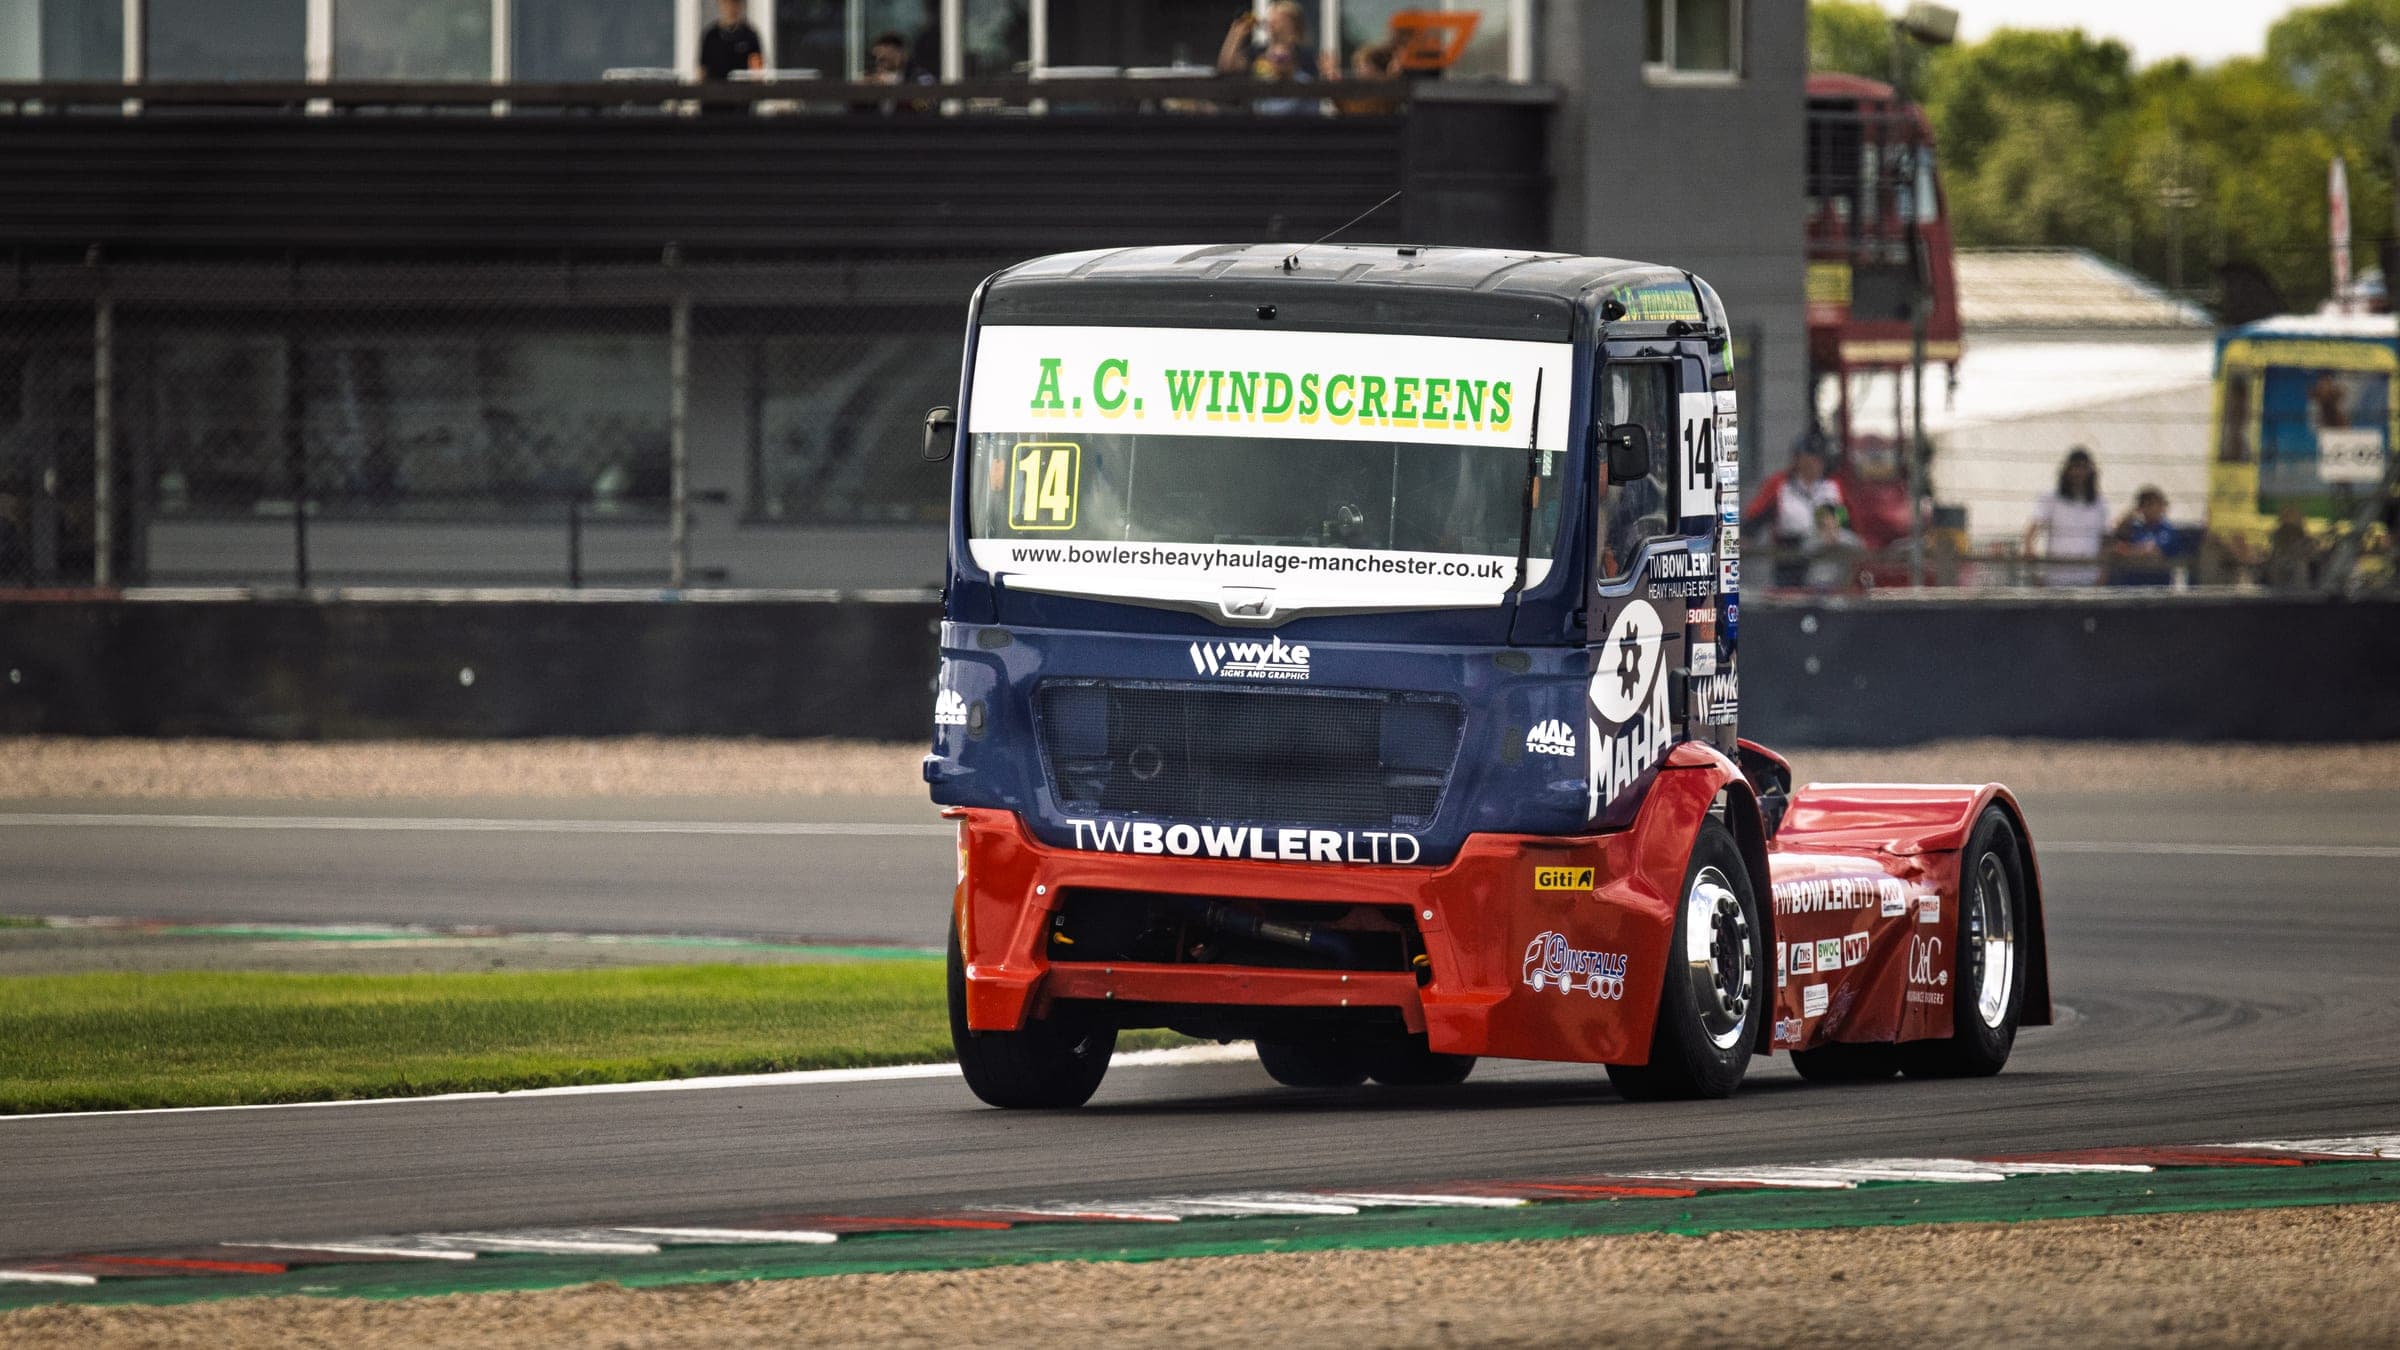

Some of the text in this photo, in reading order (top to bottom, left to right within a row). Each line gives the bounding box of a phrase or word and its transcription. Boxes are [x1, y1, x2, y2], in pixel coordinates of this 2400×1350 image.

[1164, 368, 1513, 431] WINDSCREENS
[1684, 417, 1715, 491] 14
[1018, 449, 1072, 522] 14
[1011, 544, 1505, 580] www.bowlersheavyhaulage-manchester.co.uk
[1648, 552, 1717, 579] TWBOWLERLT
[1648, 583, 1668, 600] HEAVY
[1668, 581, 1698, 599] HAULAGE
[1698, 580, 1710, 597] EST
[1228, 634, 1311, 671] wyke
[1220, 669, 1310, 681] SIGNS AND GRAPHICS
[1527, 718, 1576, 747] MAC
[1587, 649, 1672, 822] MAHA
[1526, 742, 1576, 757] TOOLS
[1065, 818, 1422, 865] TWBOWLERLTD
[1538, 870, 1573, 888] Giti
[1567, 948, 1628, 978] INSTALLS
[1818, 942, 1839, 957] BWOC
